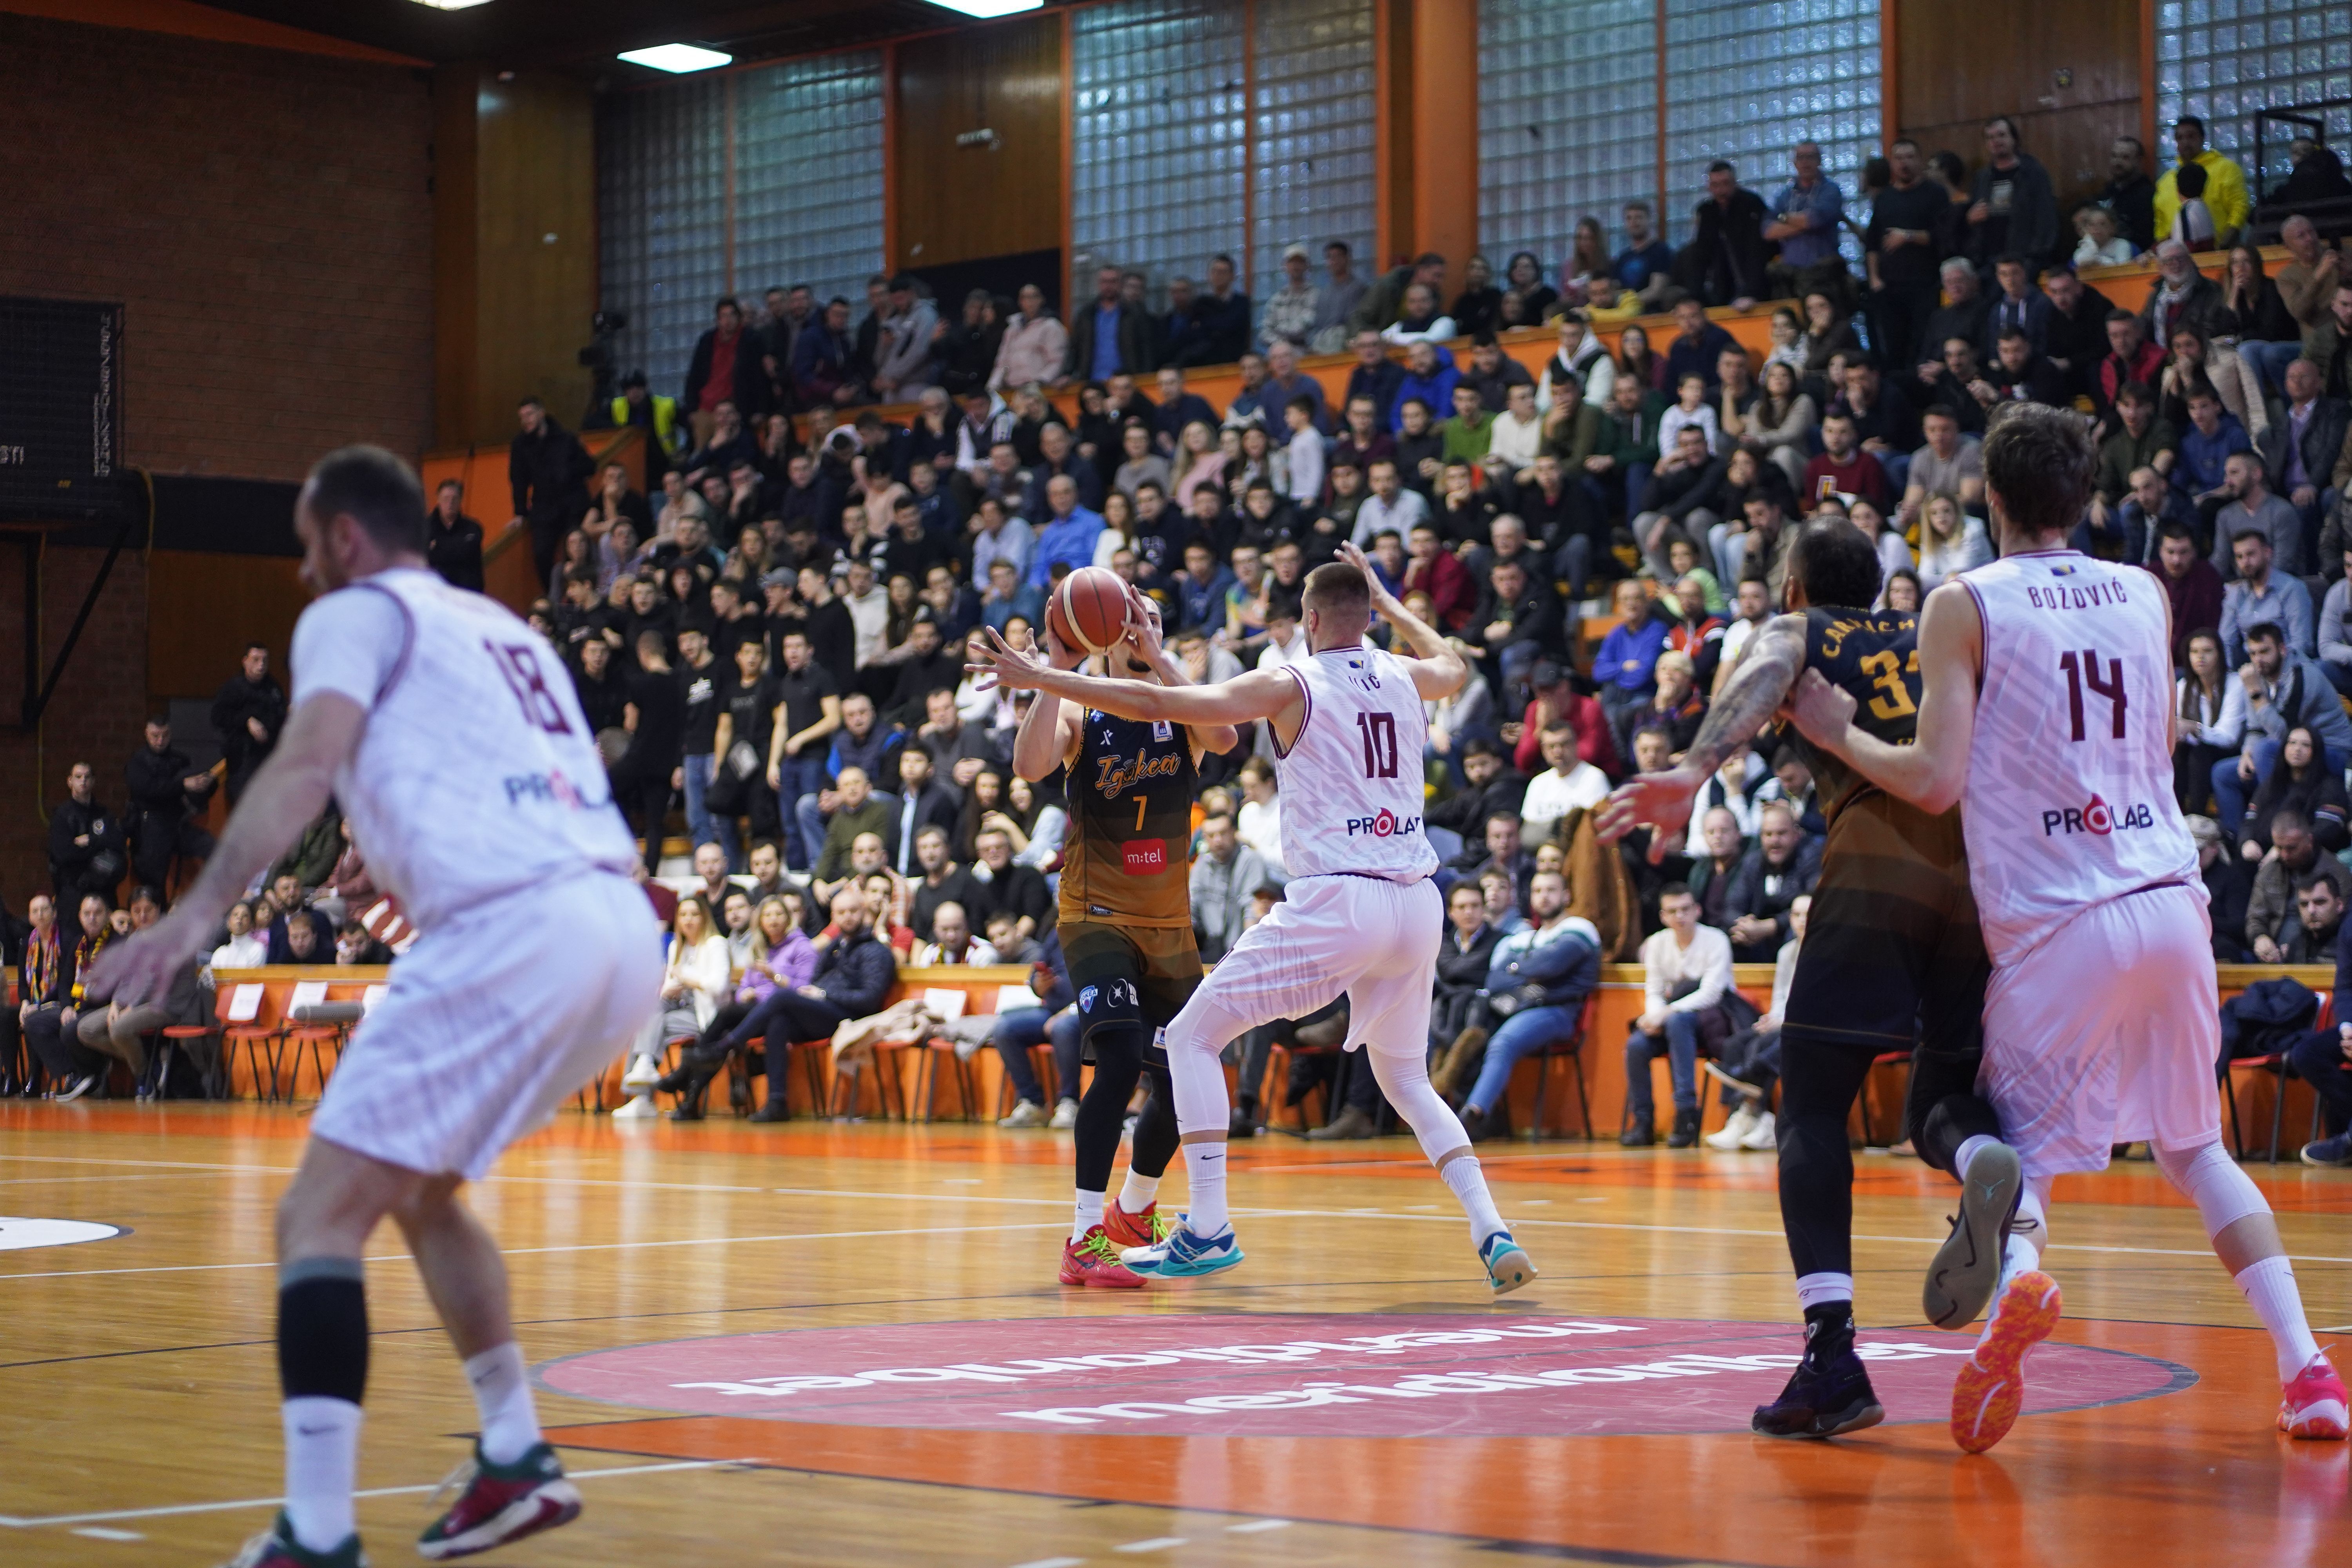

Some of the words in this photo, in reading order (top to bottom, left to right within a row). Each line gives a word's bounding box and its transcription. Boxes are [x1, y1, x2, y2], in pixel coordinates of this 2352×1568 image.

[2027, 576, 2128, 610] BOŽOVIĆ
[482, 638, 573, 735] 18
[1860, 650, 1920, 720] 3
[2060, 649, 2127, 742] 14
[1094, 748, 1181, 799] Igokea
[1356, 712, 1398, 778] 10
[1132, 795, 1147, 831] 7
[2043, 793, 2154, 837] PROLAB
[1127, 848, 1161, 864] m:tel
[668, 1321, 1649, 1396] meridianbet
[997, 1341, 1976, 1424] meridianbet
